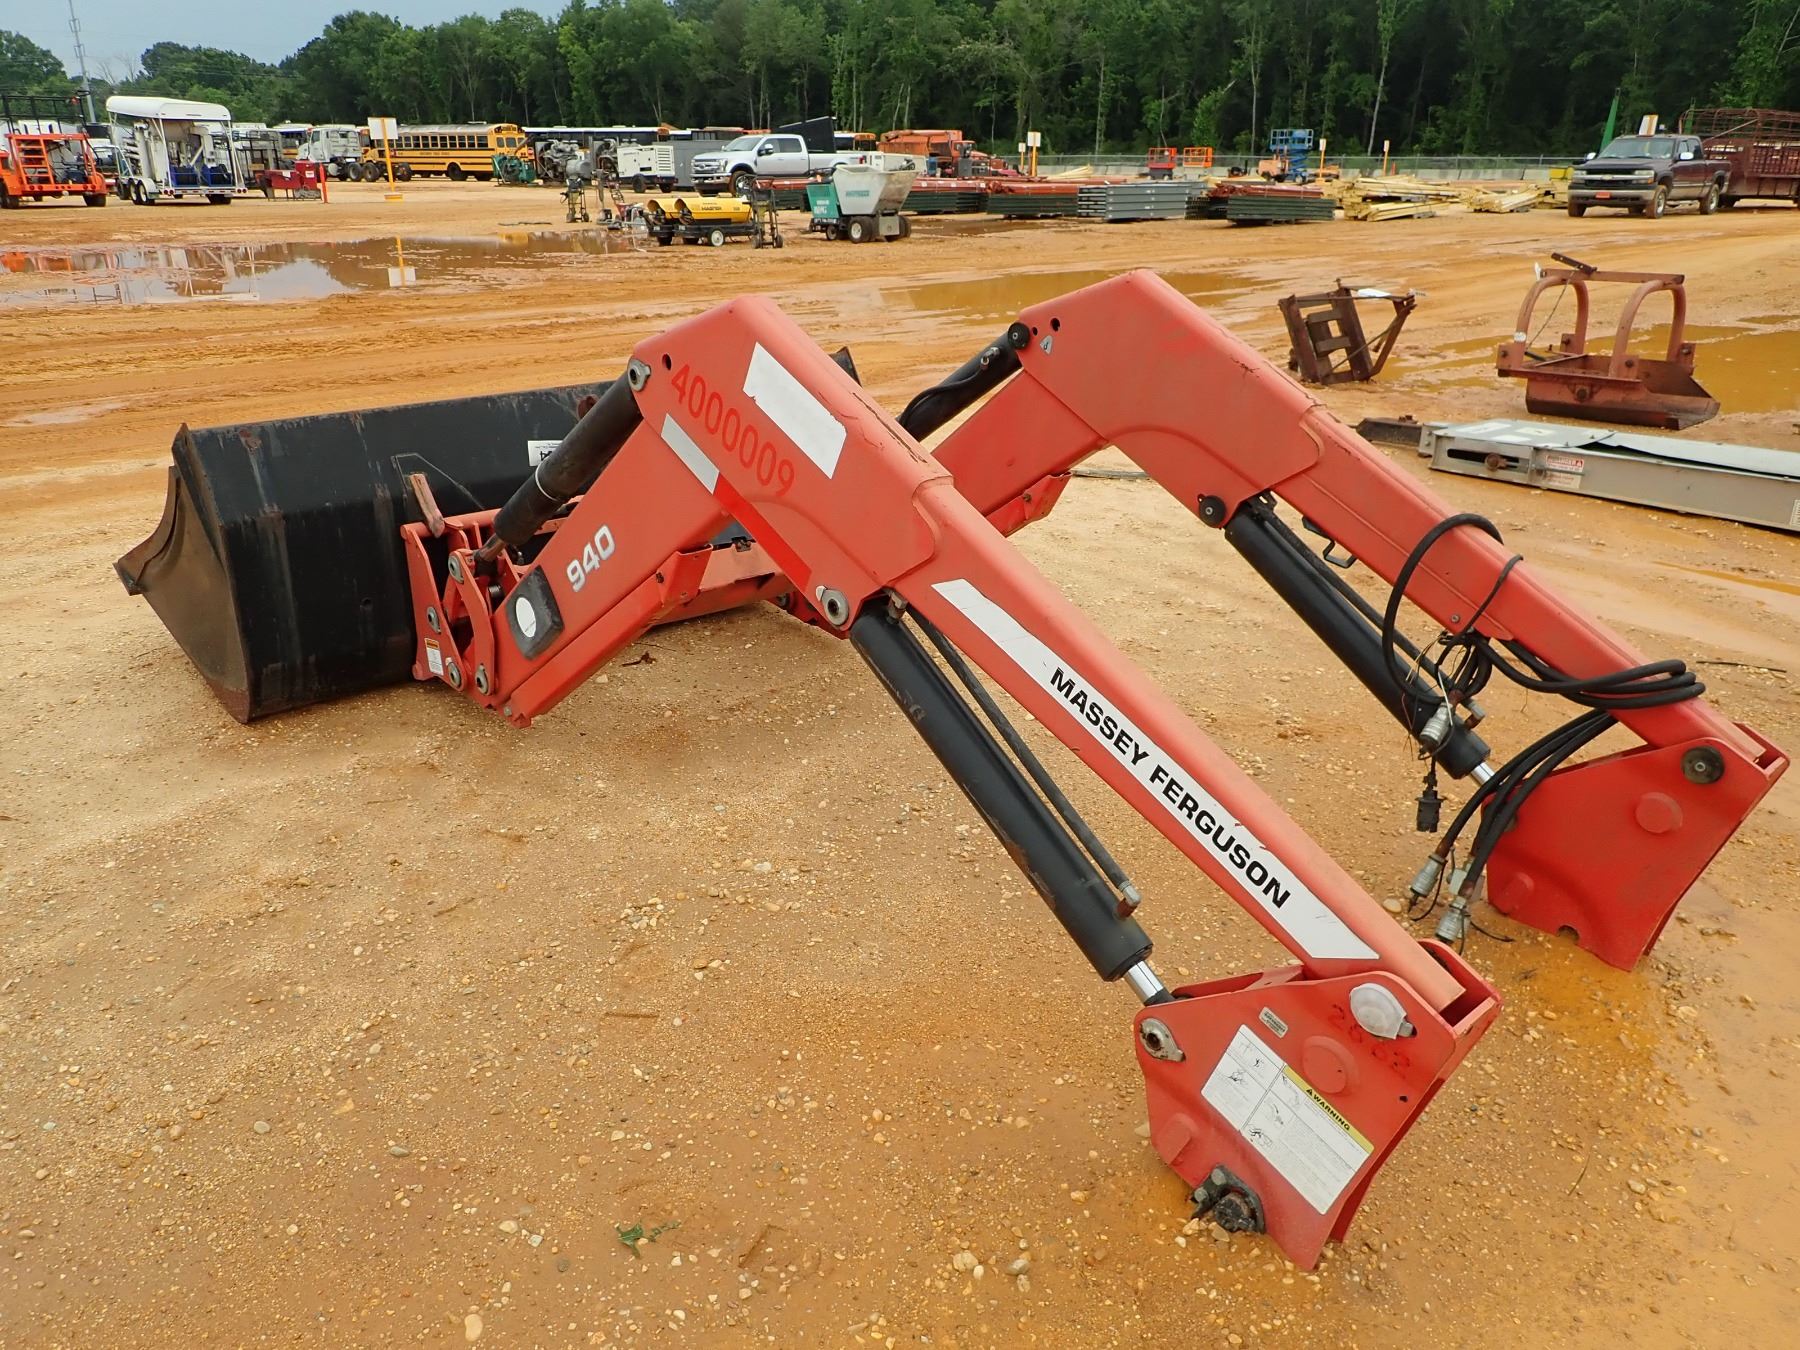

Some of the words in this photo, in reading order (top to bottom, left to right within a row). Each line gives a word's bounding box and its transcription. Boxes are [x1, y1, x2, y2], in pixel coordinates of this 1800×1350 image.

[671, 364, 795, 497] 4000009
[566, 525, 616, 592] 940
[1050, 667, 1149, 766] MASSEY
[1149, 764, 1291, 908] FERGUSON
[1313, 1094, 1350, 1130] WARNING
